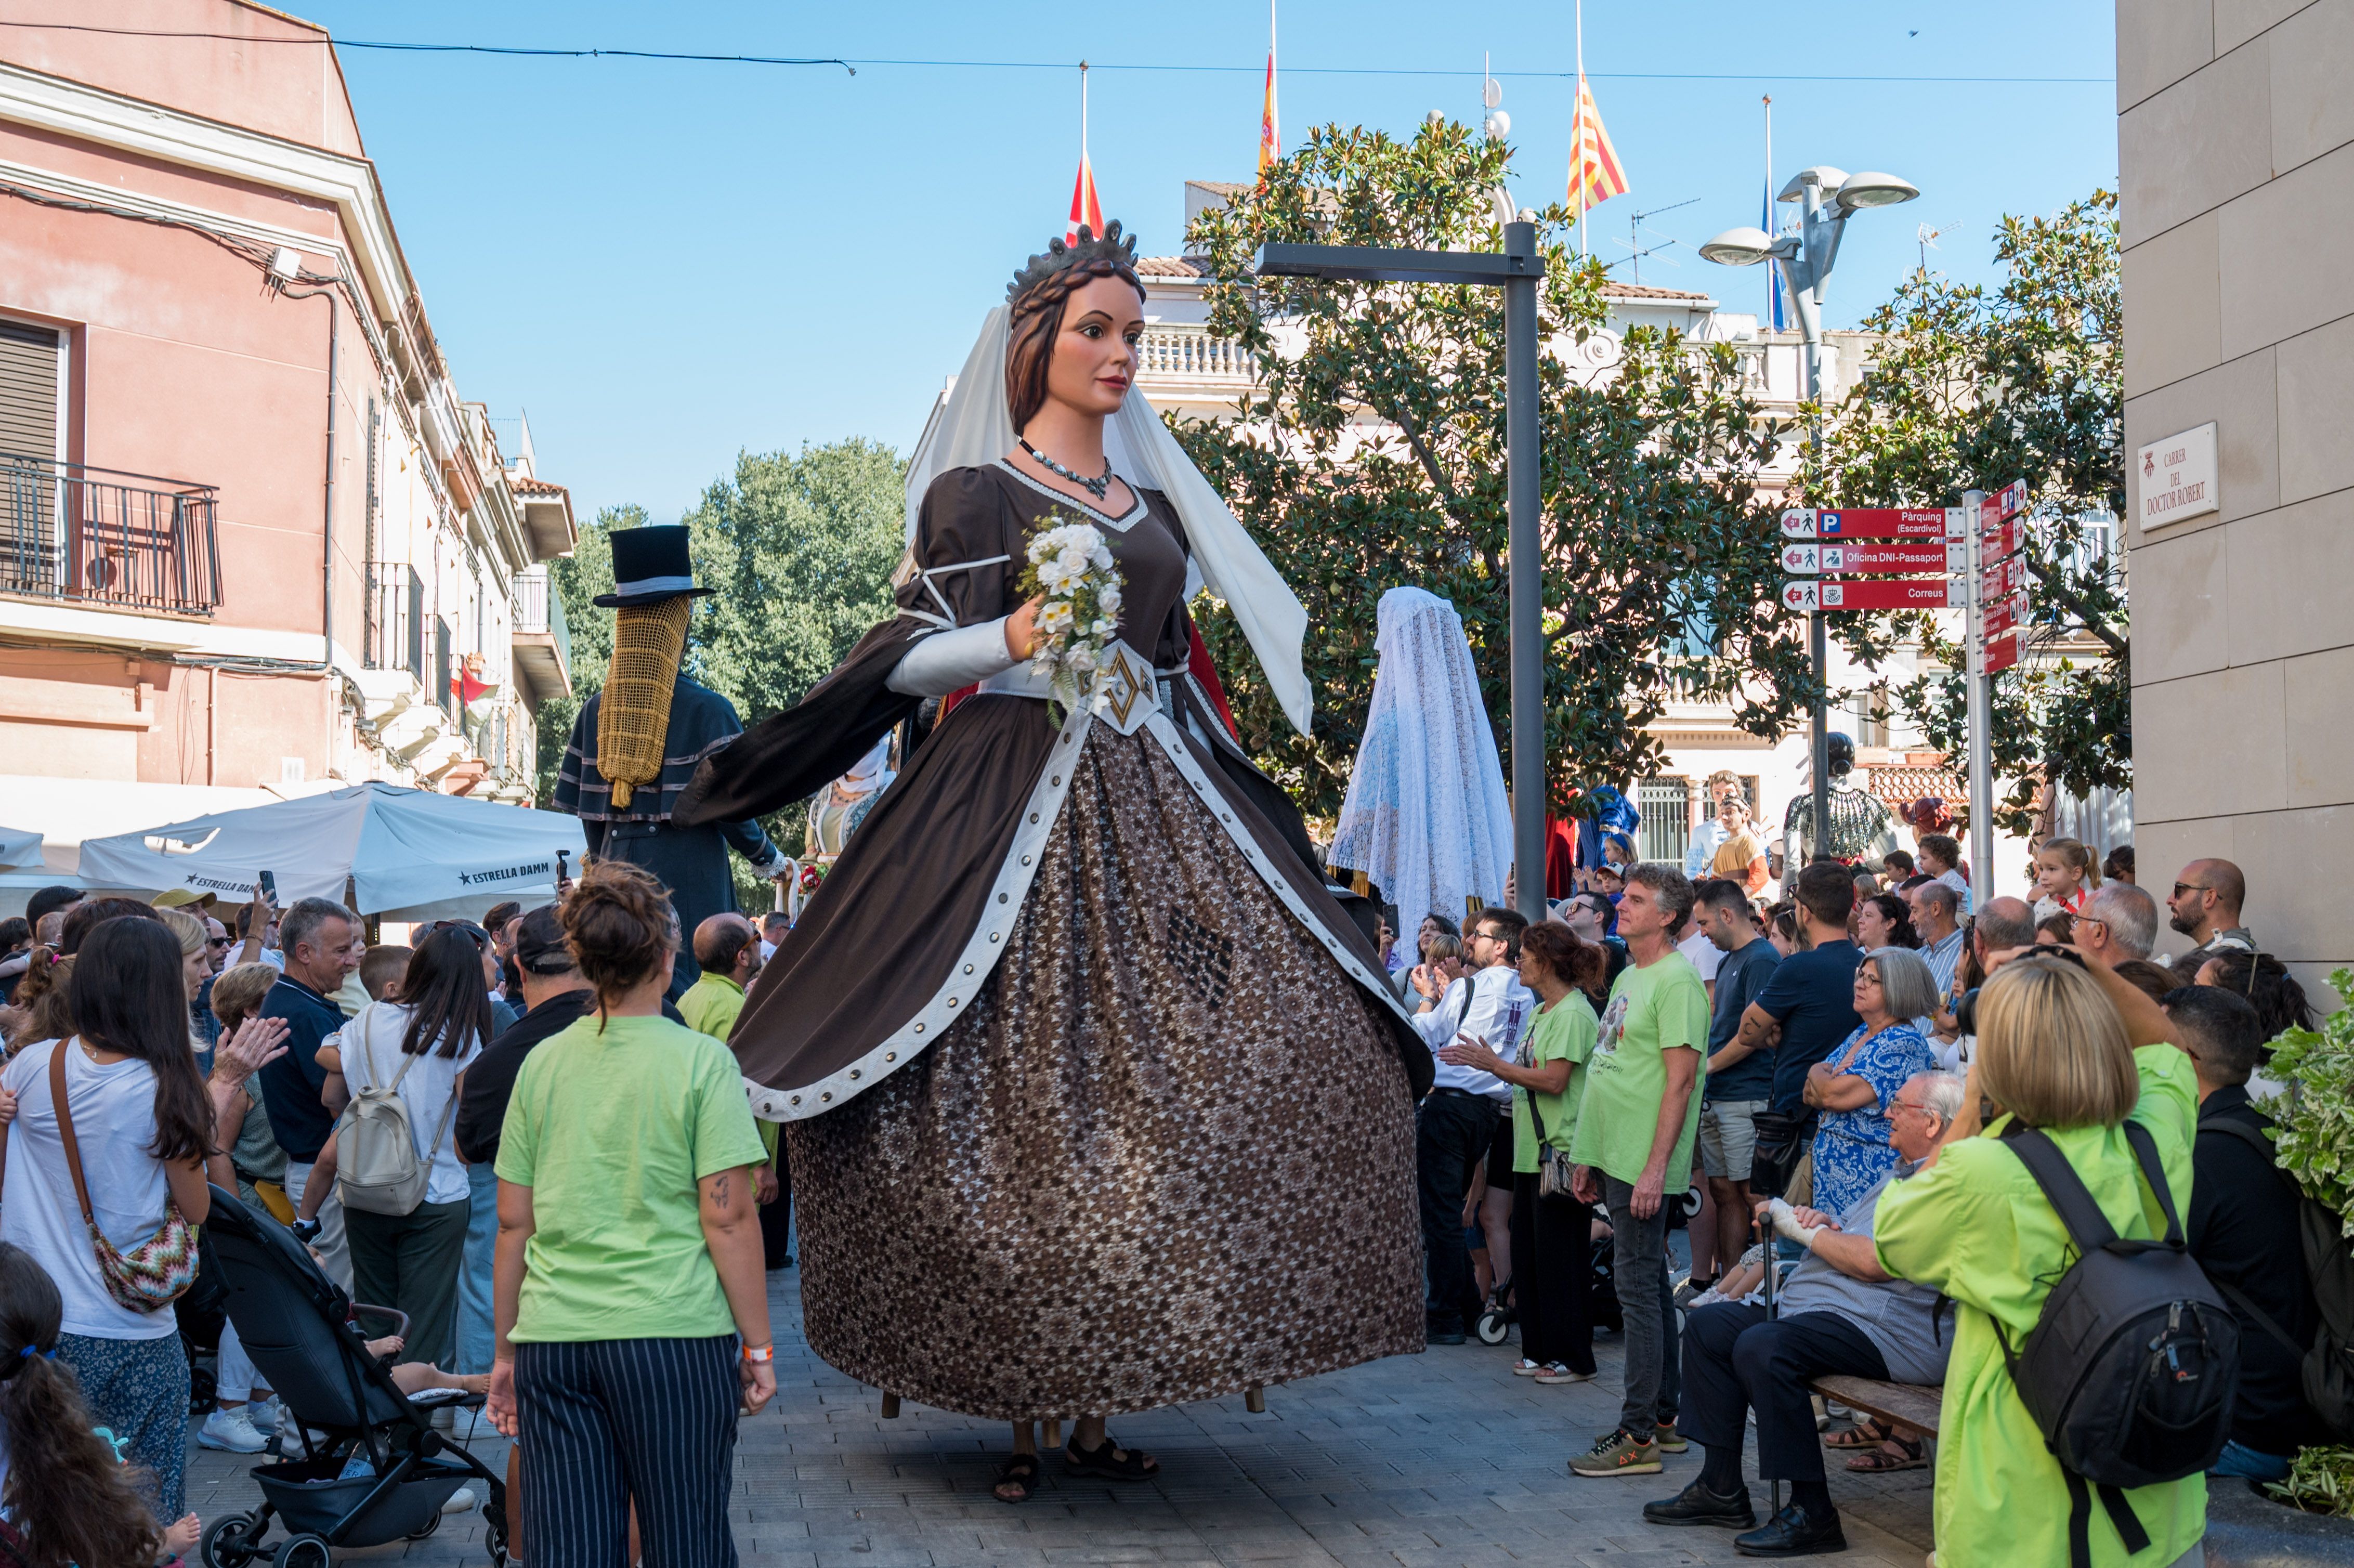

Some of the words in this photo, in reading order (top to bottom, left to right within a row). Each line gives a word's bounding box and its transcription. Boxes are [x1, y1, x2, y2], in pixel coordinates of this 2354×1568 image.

[2164, 448, 2186, 467] CARRER
[2170, 472, 2181, 487] DEL
[2147, 491, 2177, 516] DOCTOR
[2178, 481, 2205, 506] ROBERT
[1824, 515, 1837, 531] P
[1902, 512, 1941, 523] Pàrquing
[1898, 524, 1941, 534] (Escardívol)
[1847, 553, 1877, 562] Oficina
[1879, 553, 1943, 563] DNI-Passaport
[1908, 588, 1943, 598] Correus
[472, 868, 517, 883] ESTRELLA
[520, 862, 549, 876] DAMM
[197, 878, 236, 891] ESTRELLA
[237, 884, 256, 894] DAM
